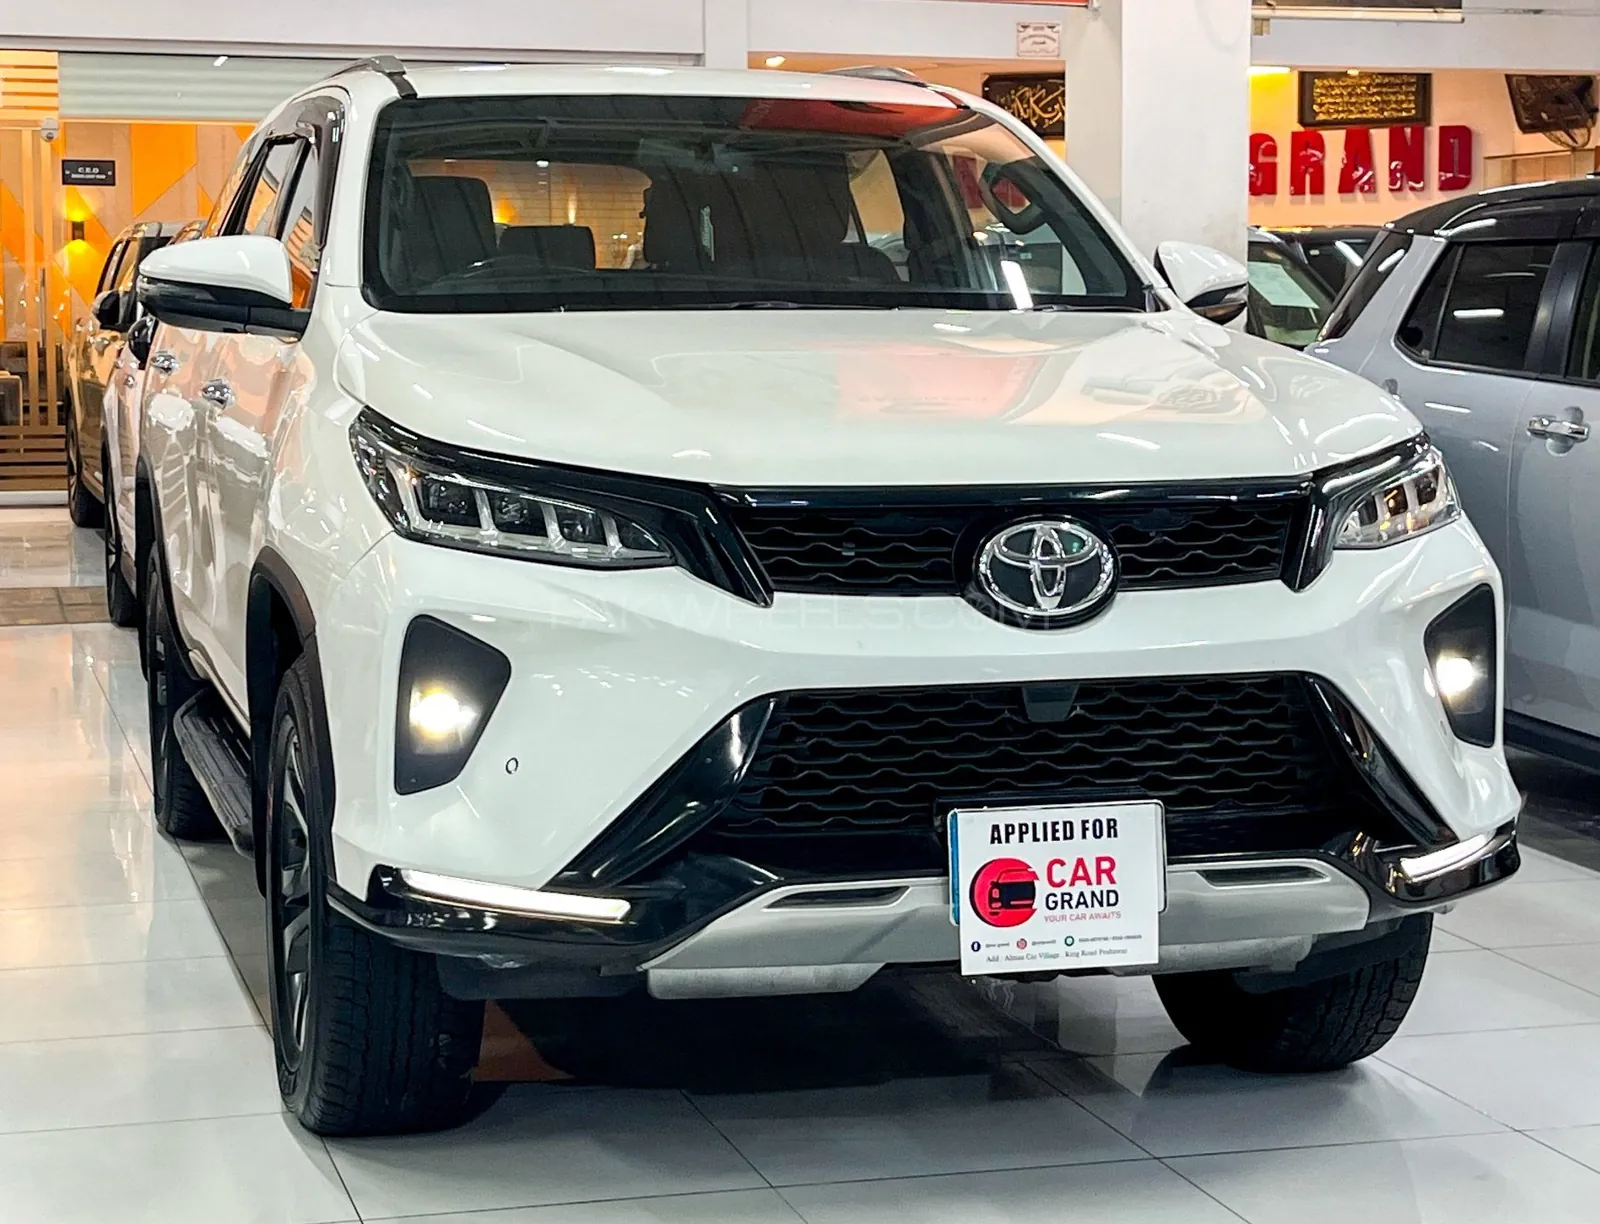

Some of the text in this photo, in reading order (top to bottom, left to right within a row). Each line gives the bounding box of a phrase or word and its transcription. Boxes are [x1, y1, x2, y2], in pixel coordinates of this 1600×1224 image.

[1249, 126, 1472, 196] GRAND
[990, 818, 1118, 845] APPLIED FOR
[1046, 856, 1117, 888] CAR
[1045, 889, 1119, 911] GRAND
[1044, 911, 1122, 923] YOUR CAR AWAITS
